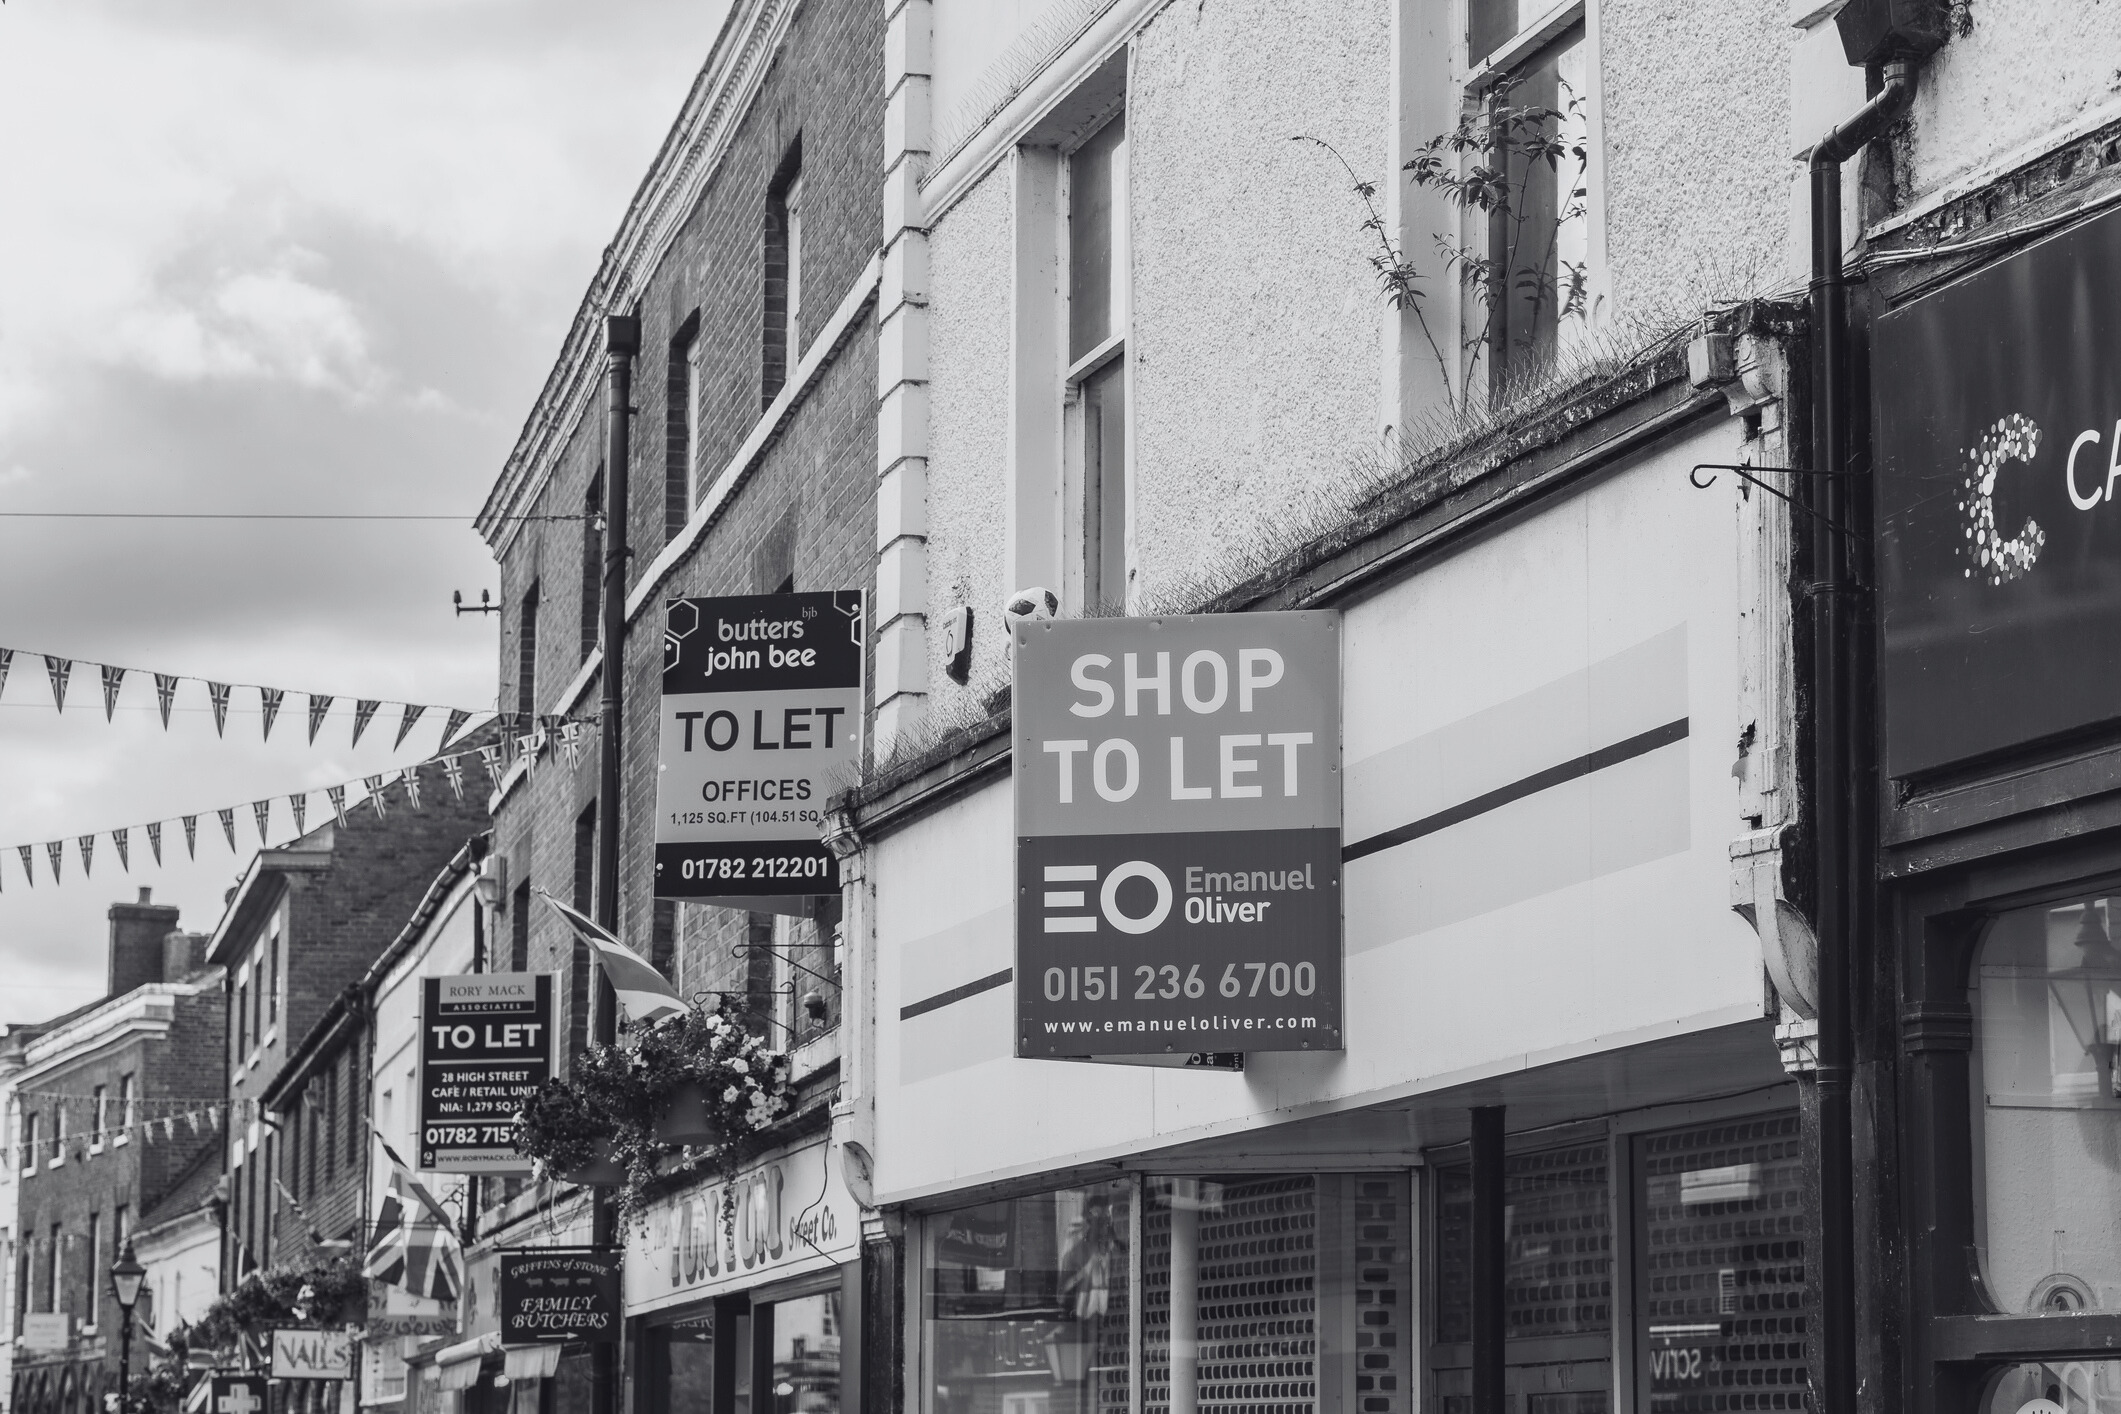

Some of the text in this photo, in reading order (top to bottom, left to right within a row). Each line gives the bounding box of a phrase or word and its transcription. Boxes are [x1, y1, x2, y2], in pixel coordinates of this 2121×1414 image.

[802, 606, 818, 621] bjb
[718, 618, 805, 642] butters
[704, 644, 817, 677] john bee
[1069, 648, 1285, 718] SHOP
[675, 707, 845, 752] TO LET
[1043, 732, 1314, 804] TO LET
[702, 779, 812, 802] OFFICES
[671, 809, 826, 826] 1,125 SQ.FT (104.51 SQ.
[681, 856, 828, 880] 01782 212201
[1185, 863, 1315, 894] Emanuel
[1044, 860, 1173, 935] EO
[1185, 896, 1272, 924] Oliver
[449, 984, 526, 997] RORY MACK
[1044, 961, 1316, 1002] 0151 236 6700
[453, 1003, 521, 1012] ASSOCIATES
[1044, 1015, 1317, 1033] www.emanueloliver.com
[432, 1023, 542, 1050] TO LET
[441, 1070, 530, 1083] 28 HIGH STREET
[469, 1086, 508, 1097] RETAIL
[510, 1085, 540, 1096] UNIT
[440, 1102, 463, 1113] NIA:
[467, 1101, 493, 1113] 1,279
[425, 1127, 478, 1145] 01782
[822, 1205, 837, 1243] Co.
[510, 1258, 609, 1279] GRIFFINS of STONE
[520, 1294, 597, 1313] FAMILY
[511, 1312, 610, 1330] BUTCHERS
